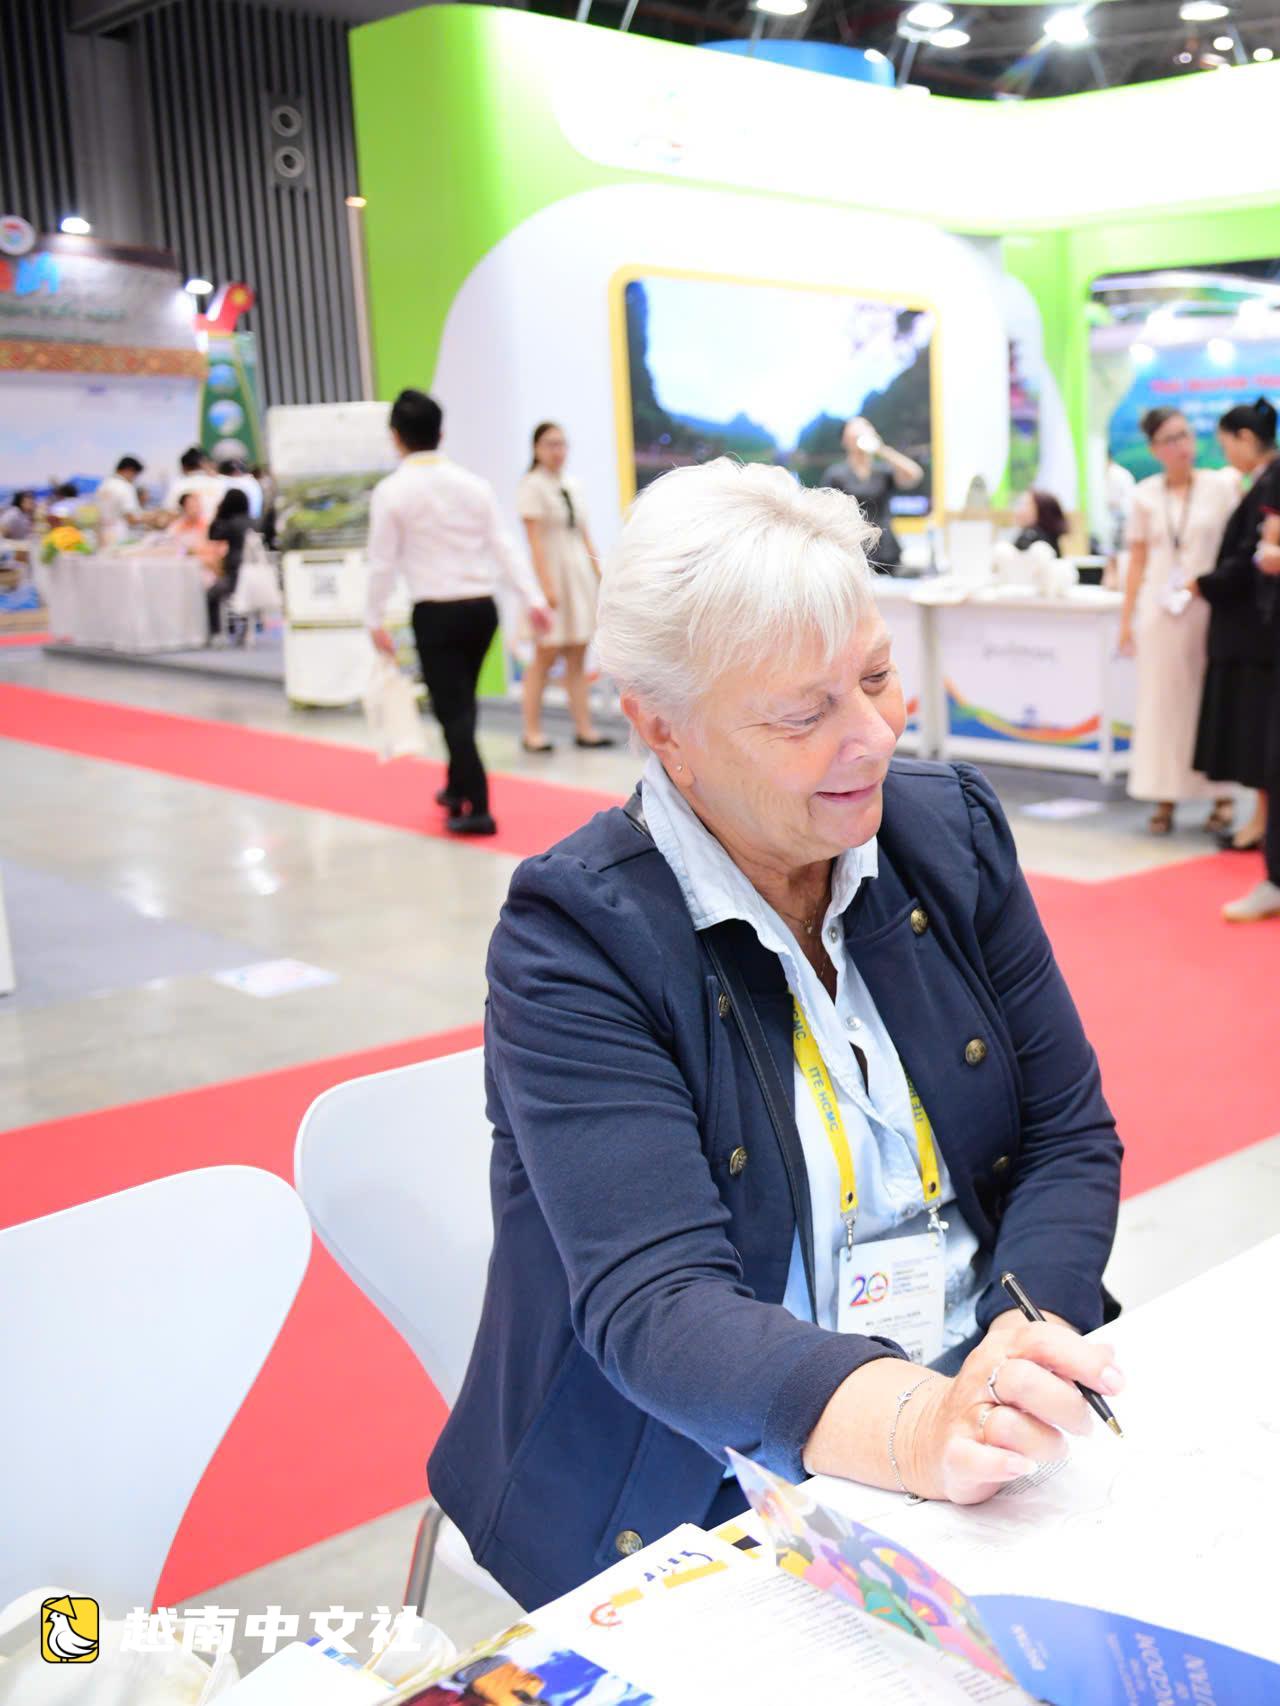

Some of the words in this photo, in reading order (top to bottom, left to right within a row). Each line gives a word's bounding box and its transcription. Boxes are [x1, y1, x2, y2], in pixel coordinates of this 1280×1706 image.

[808, 1066, 825, 1089] ITE
[818, 1090, 840, 1132] HCMC
[849, 1271, 889, 1308] 20
